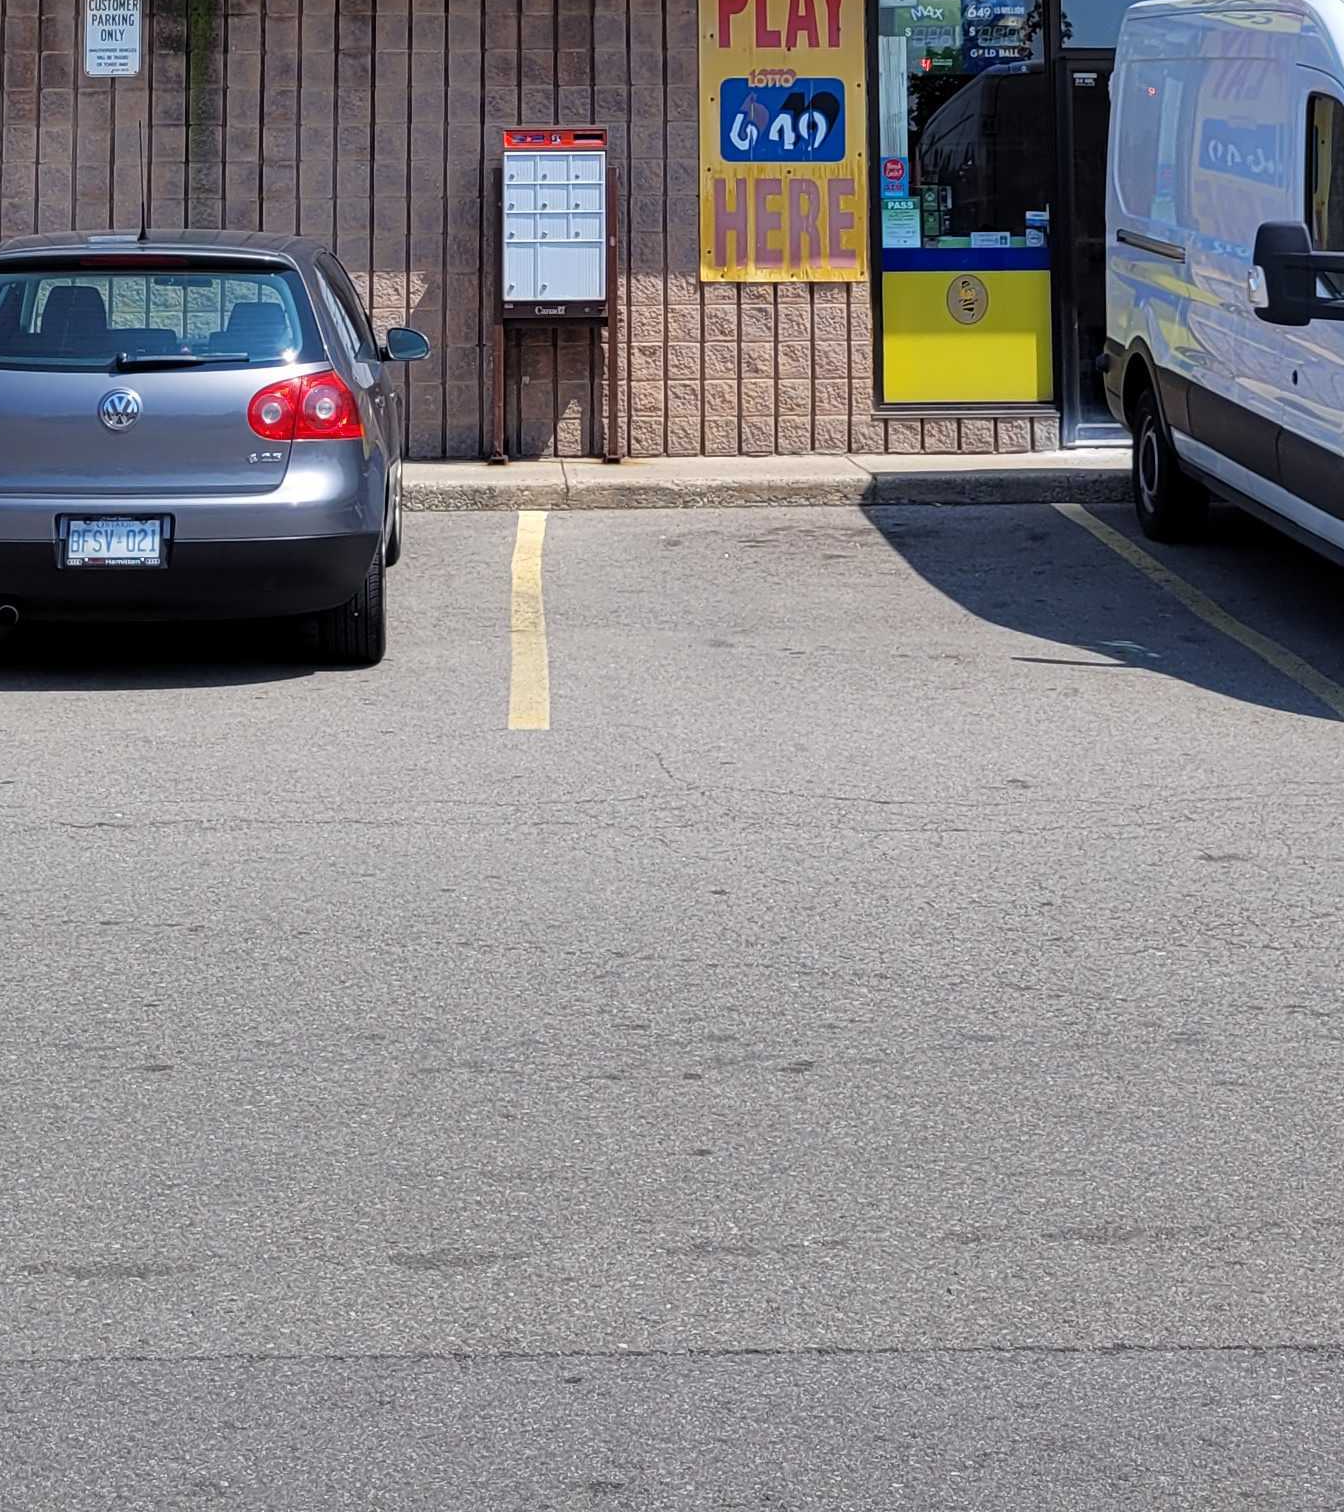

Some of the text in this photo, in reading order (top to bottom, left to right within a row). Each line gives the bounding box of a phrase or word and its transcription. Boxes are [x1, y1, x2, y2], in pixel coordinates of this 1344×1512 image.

[91, 14, 135, 27] PARKING
[100, 28, 126, 42] ONLY
[887, 200, 914, 210] PASS
[713, 178, 857, 269] HERE
[70, 529, 156, 553] BFSV 021
